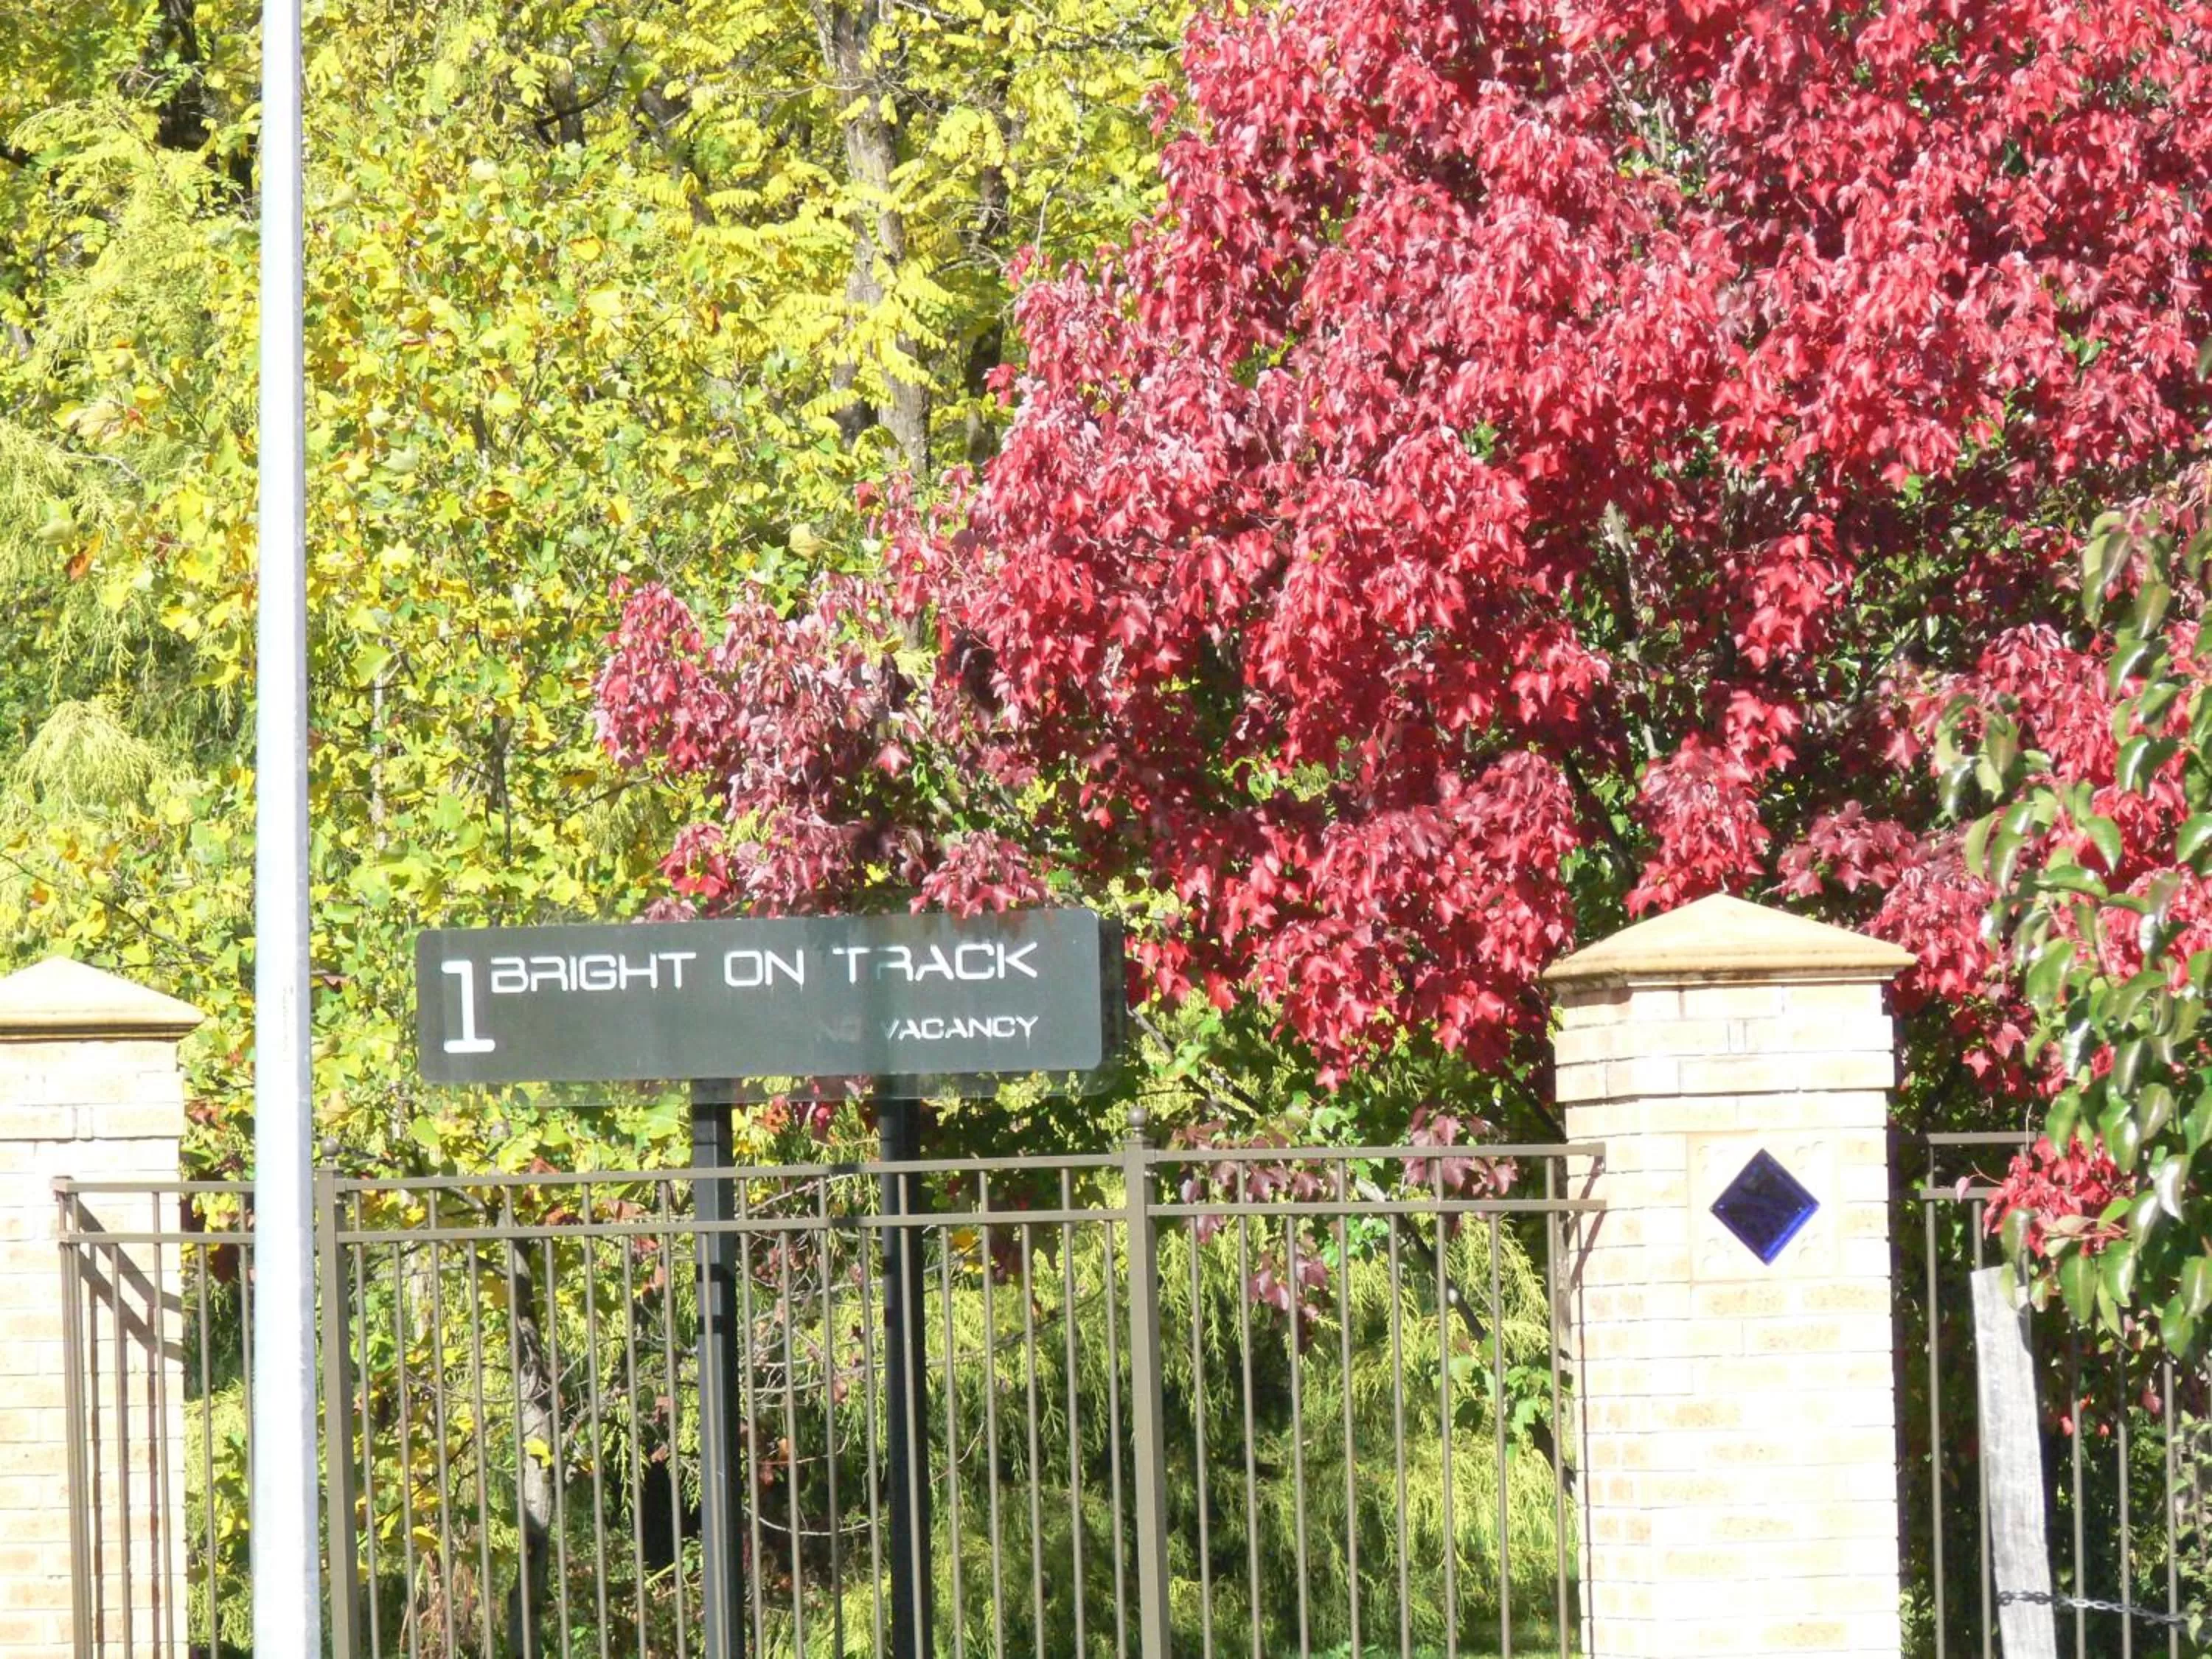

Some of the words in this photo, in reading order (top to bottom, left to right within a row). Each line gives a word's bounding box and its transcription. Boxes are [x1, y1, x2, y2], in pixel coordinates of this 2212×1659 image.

[441, 960, 495, 1054] 1
[490, 953, 697, 993] BRIGHT
[723, 948, 805, 989] ON
[832, 942, 1038, 983] TRACK
